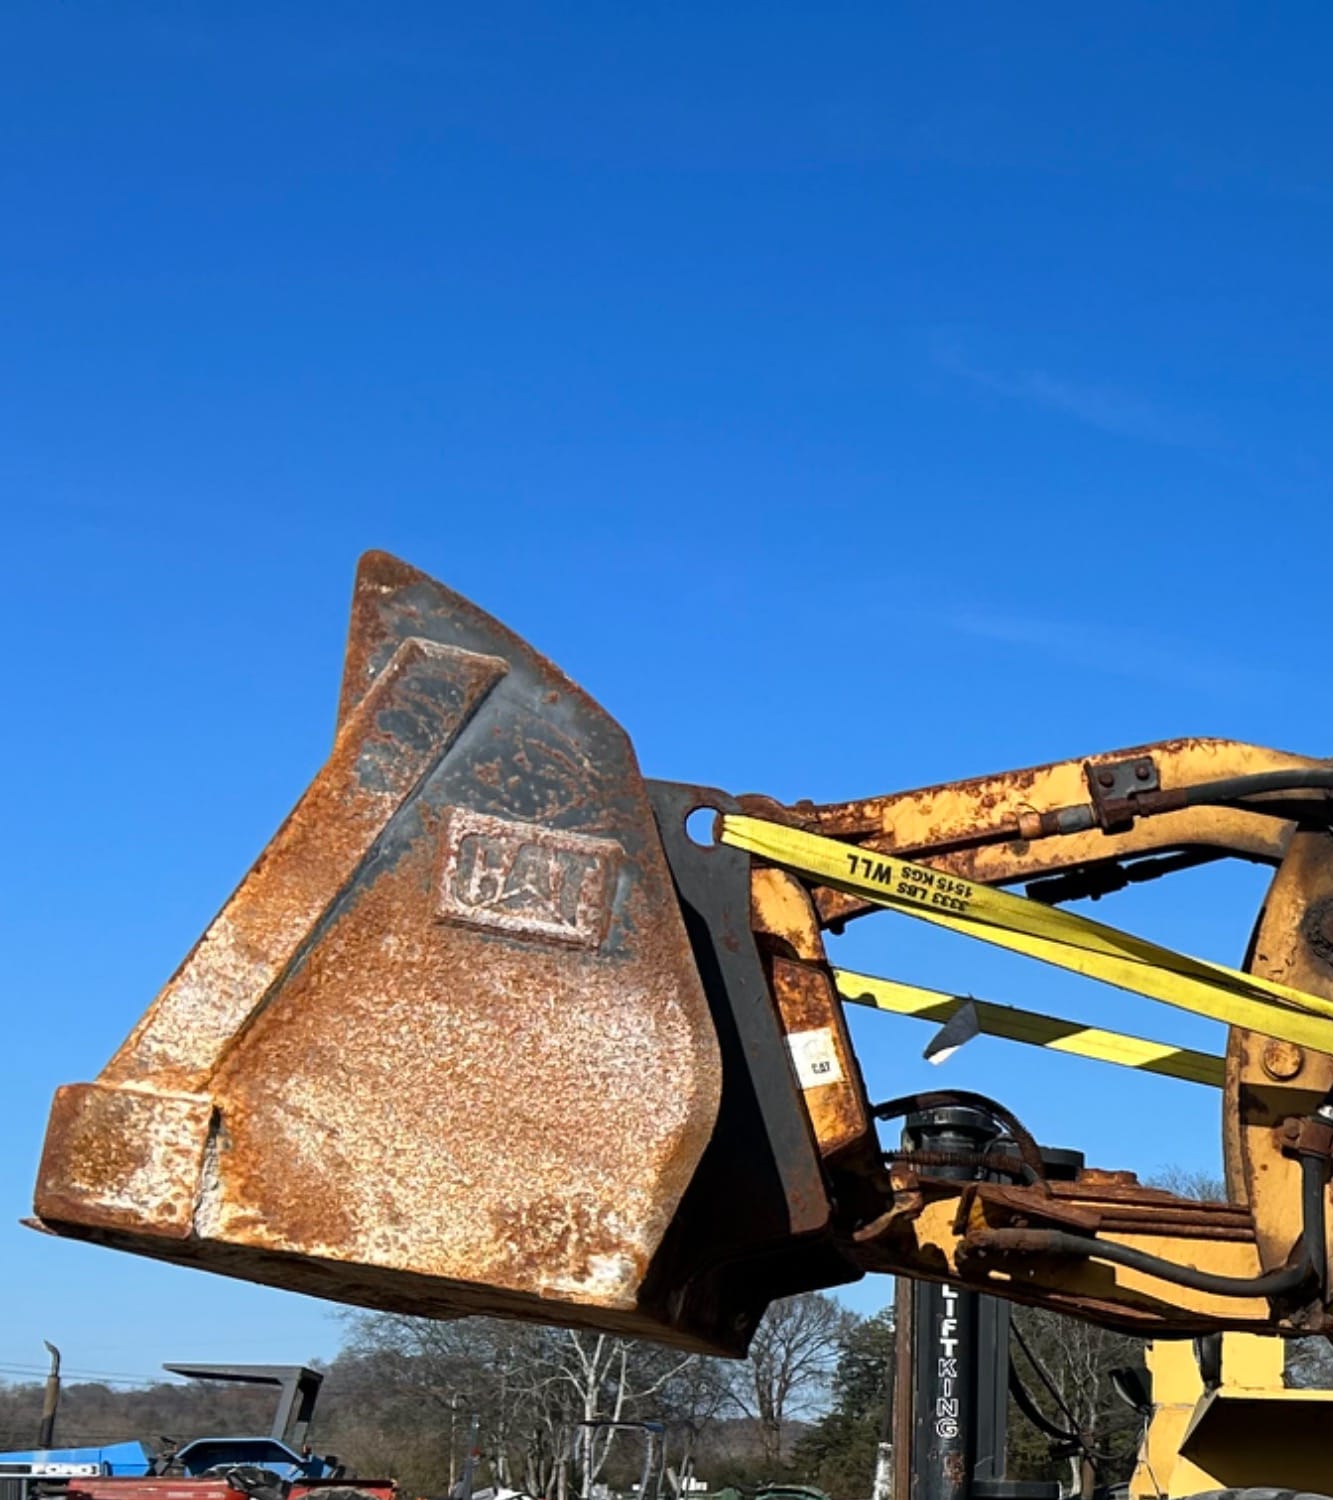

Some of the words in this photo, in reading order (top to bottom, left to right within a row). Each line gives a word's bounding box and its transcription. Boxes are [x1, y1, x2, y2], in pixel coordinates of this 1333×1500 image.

[847, 853, 892, 885] WLL
[901, 866, 934, 885] KGS
[896, 882, 928, 900] LBS
[937, 877, 973, 898] 1515
[932, 892, 970, 911] 3333
